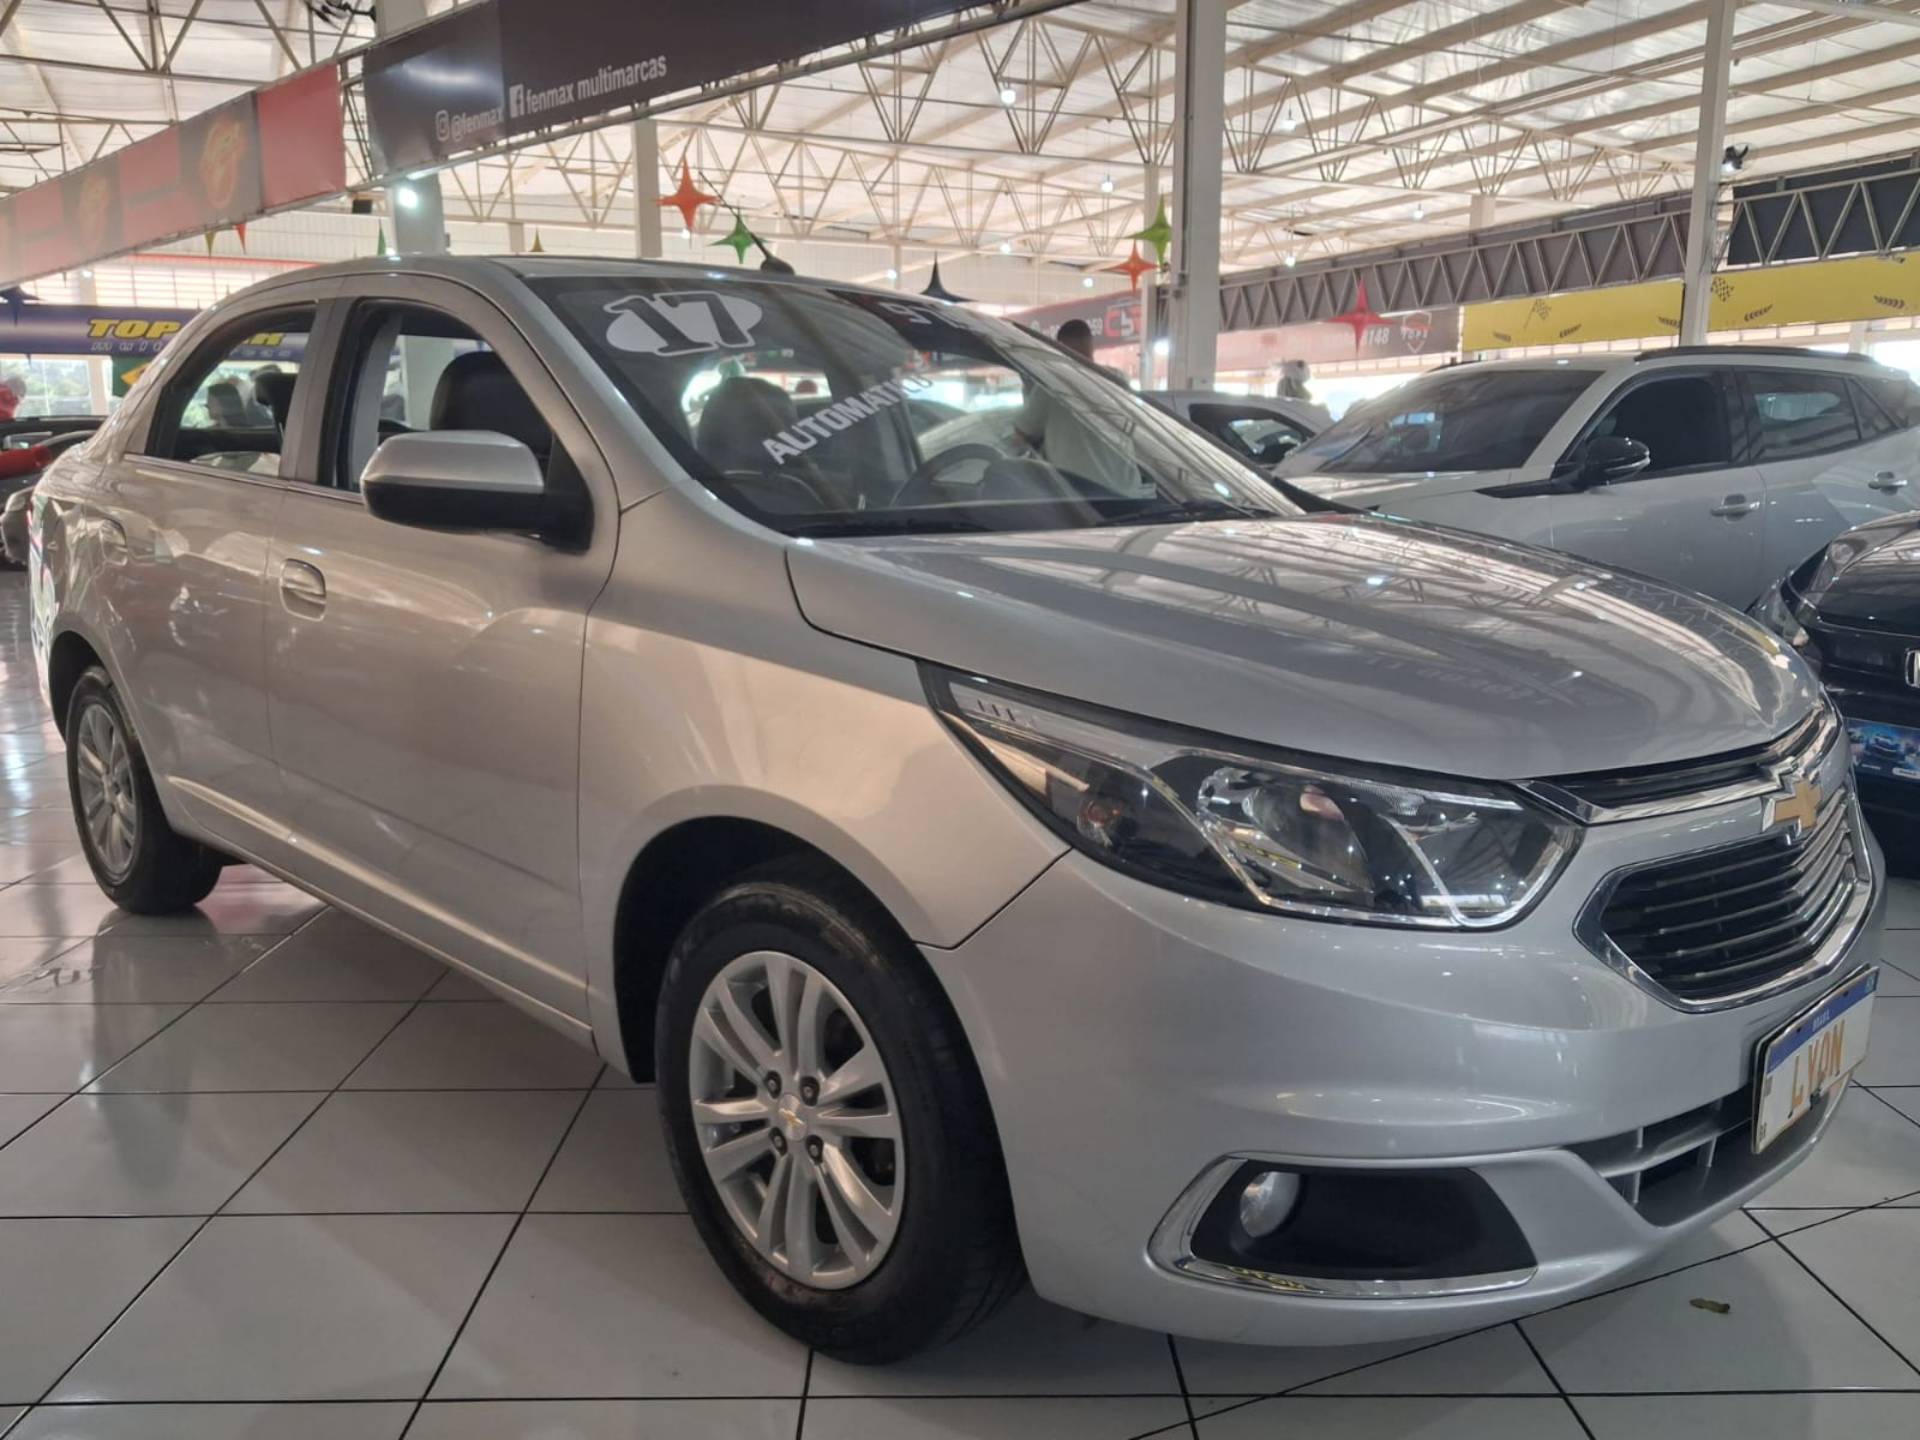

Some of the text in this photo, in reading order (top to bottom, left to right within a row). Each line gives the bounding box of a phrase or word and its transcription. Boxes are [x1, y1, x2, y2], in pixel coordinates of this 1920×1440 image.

[526, 82, 575, 115] fenmax
[577, 54, 668, 100] multimarcas
[89, 319, 181, 339] TOP
[603, 290, 756, 356] 17
